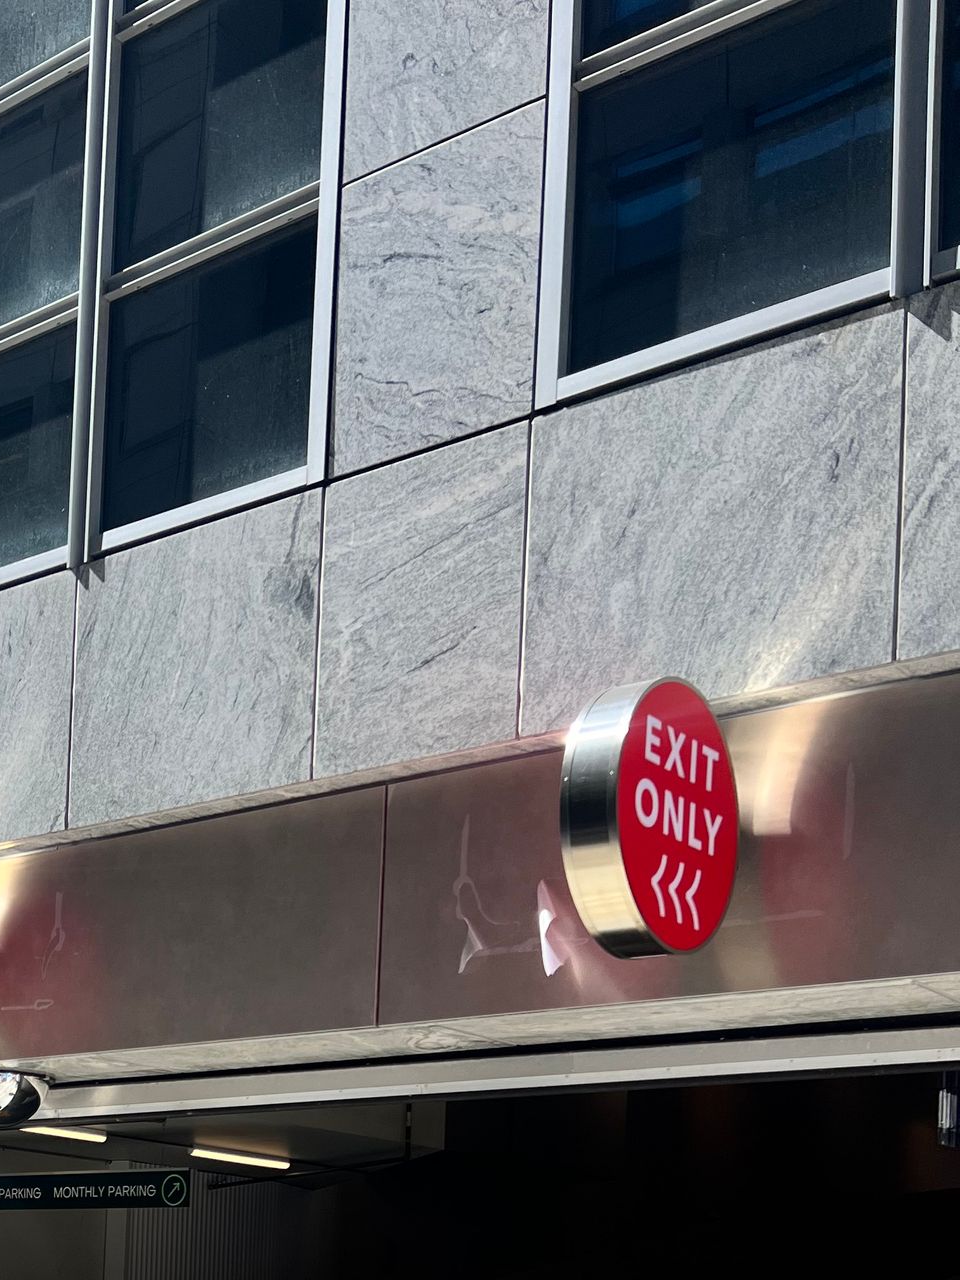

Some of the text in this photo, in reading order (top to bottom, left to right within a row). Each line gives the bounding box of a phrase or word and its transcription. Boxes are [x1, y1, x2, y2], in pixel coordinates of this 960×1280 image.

[644, 714, 720, 792] EXIT
[635, 778, 723, 856] ONLY
[53, 1184, 157, 1199] MONTHLY PARKING
